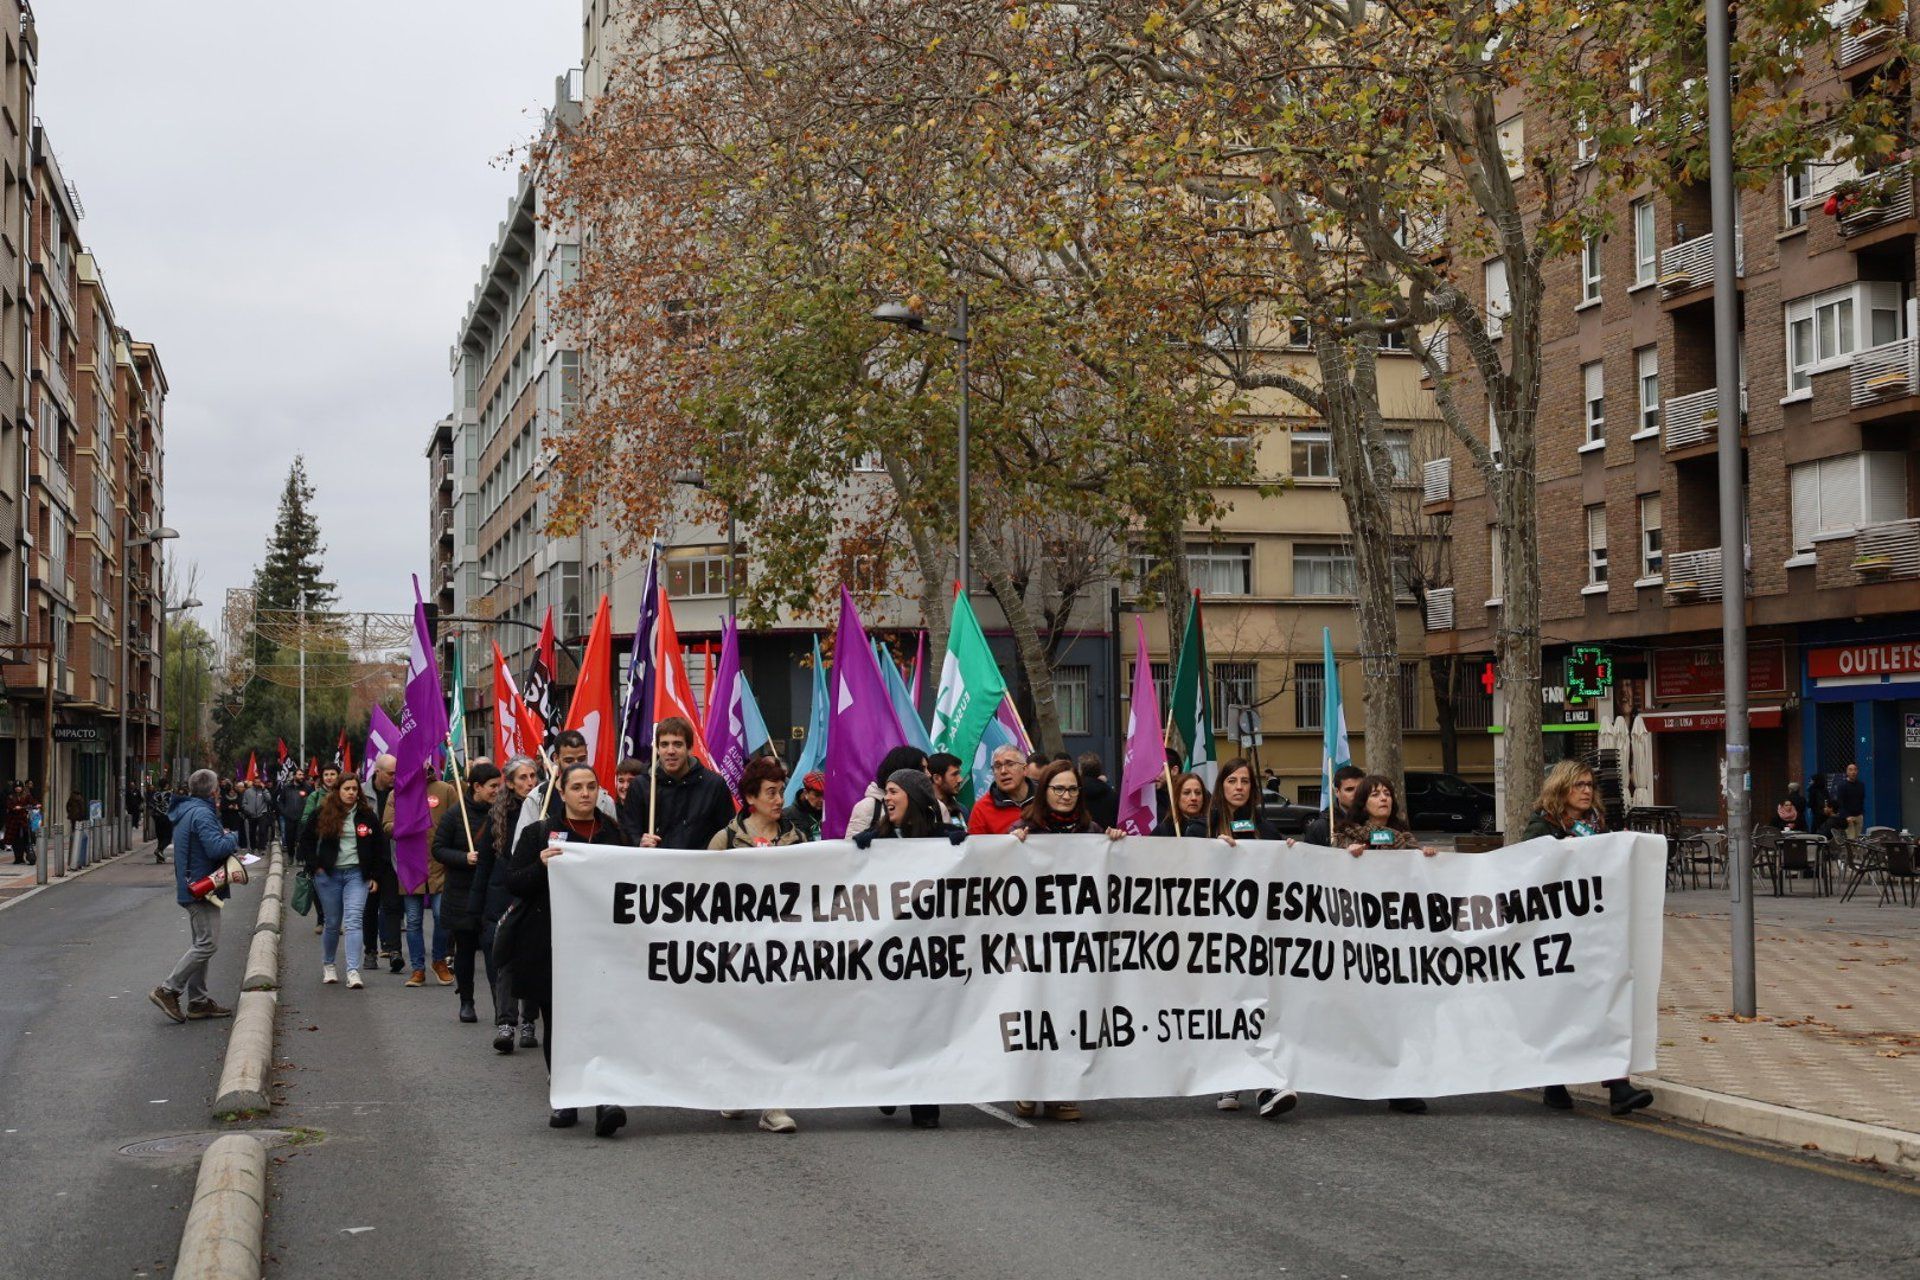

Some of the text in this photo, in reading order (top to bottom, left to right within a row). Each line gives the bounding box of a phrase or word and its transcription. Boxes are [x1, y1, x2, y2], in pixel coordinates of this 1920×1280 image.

[1839, 644, 1920, 674] OUTLETS
[55, 728, 96, 738] IMPACTO
[613, 873, 1605, 934] EUSKARAZ LAN EGITEKO ETA BIZITZEKO ESKUBIDEA BERMATU!
[648, 929, 1576, 987] EUSKARARIK GABE, KALITATEZKO ZERBITZU PUBLIKORIK EZ
[999, 1004, 1266, 1054] ELA LAB STEILAS
